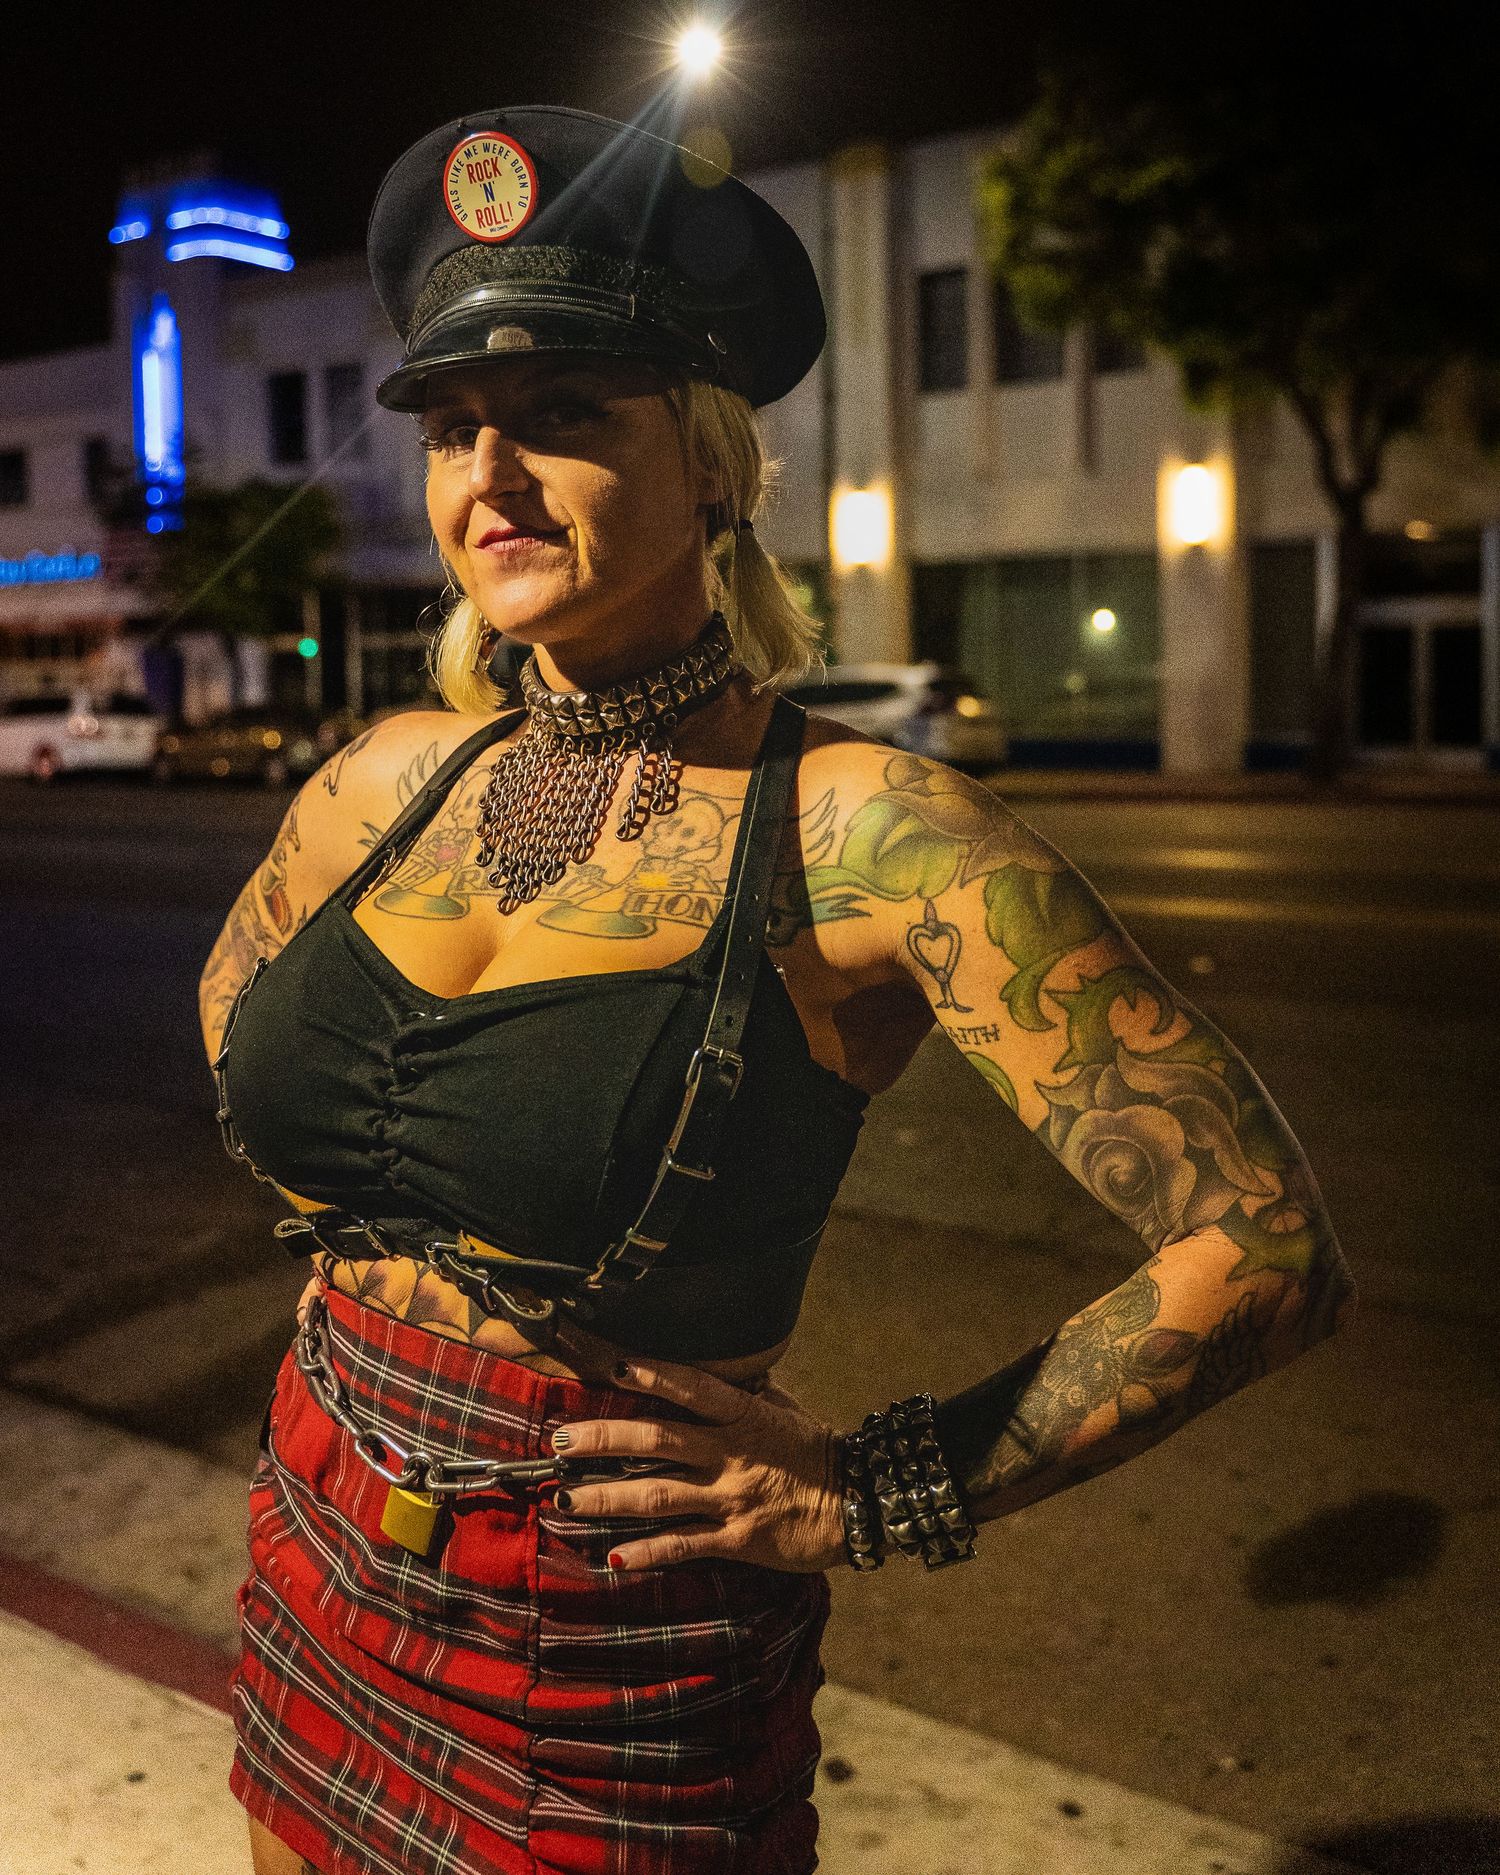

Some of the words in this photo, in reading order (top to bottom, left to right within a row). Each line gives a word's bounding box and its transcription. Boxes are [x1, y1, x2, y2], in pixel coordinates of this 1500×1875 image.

[464, 145, 478, 160] ME
[482, 143, 511, 160] WERE
[450, 159, 464, 183] LIKE
[466, 157, 502, 184] ROCK
[511, 159, 528, 188] BORN
[480, 181, 495, 203] 'N'
[518, 196, 528, 208] TO
[450, 190, 468, 222] GIRLS
[475, 202, 514, 229] ROLL!
